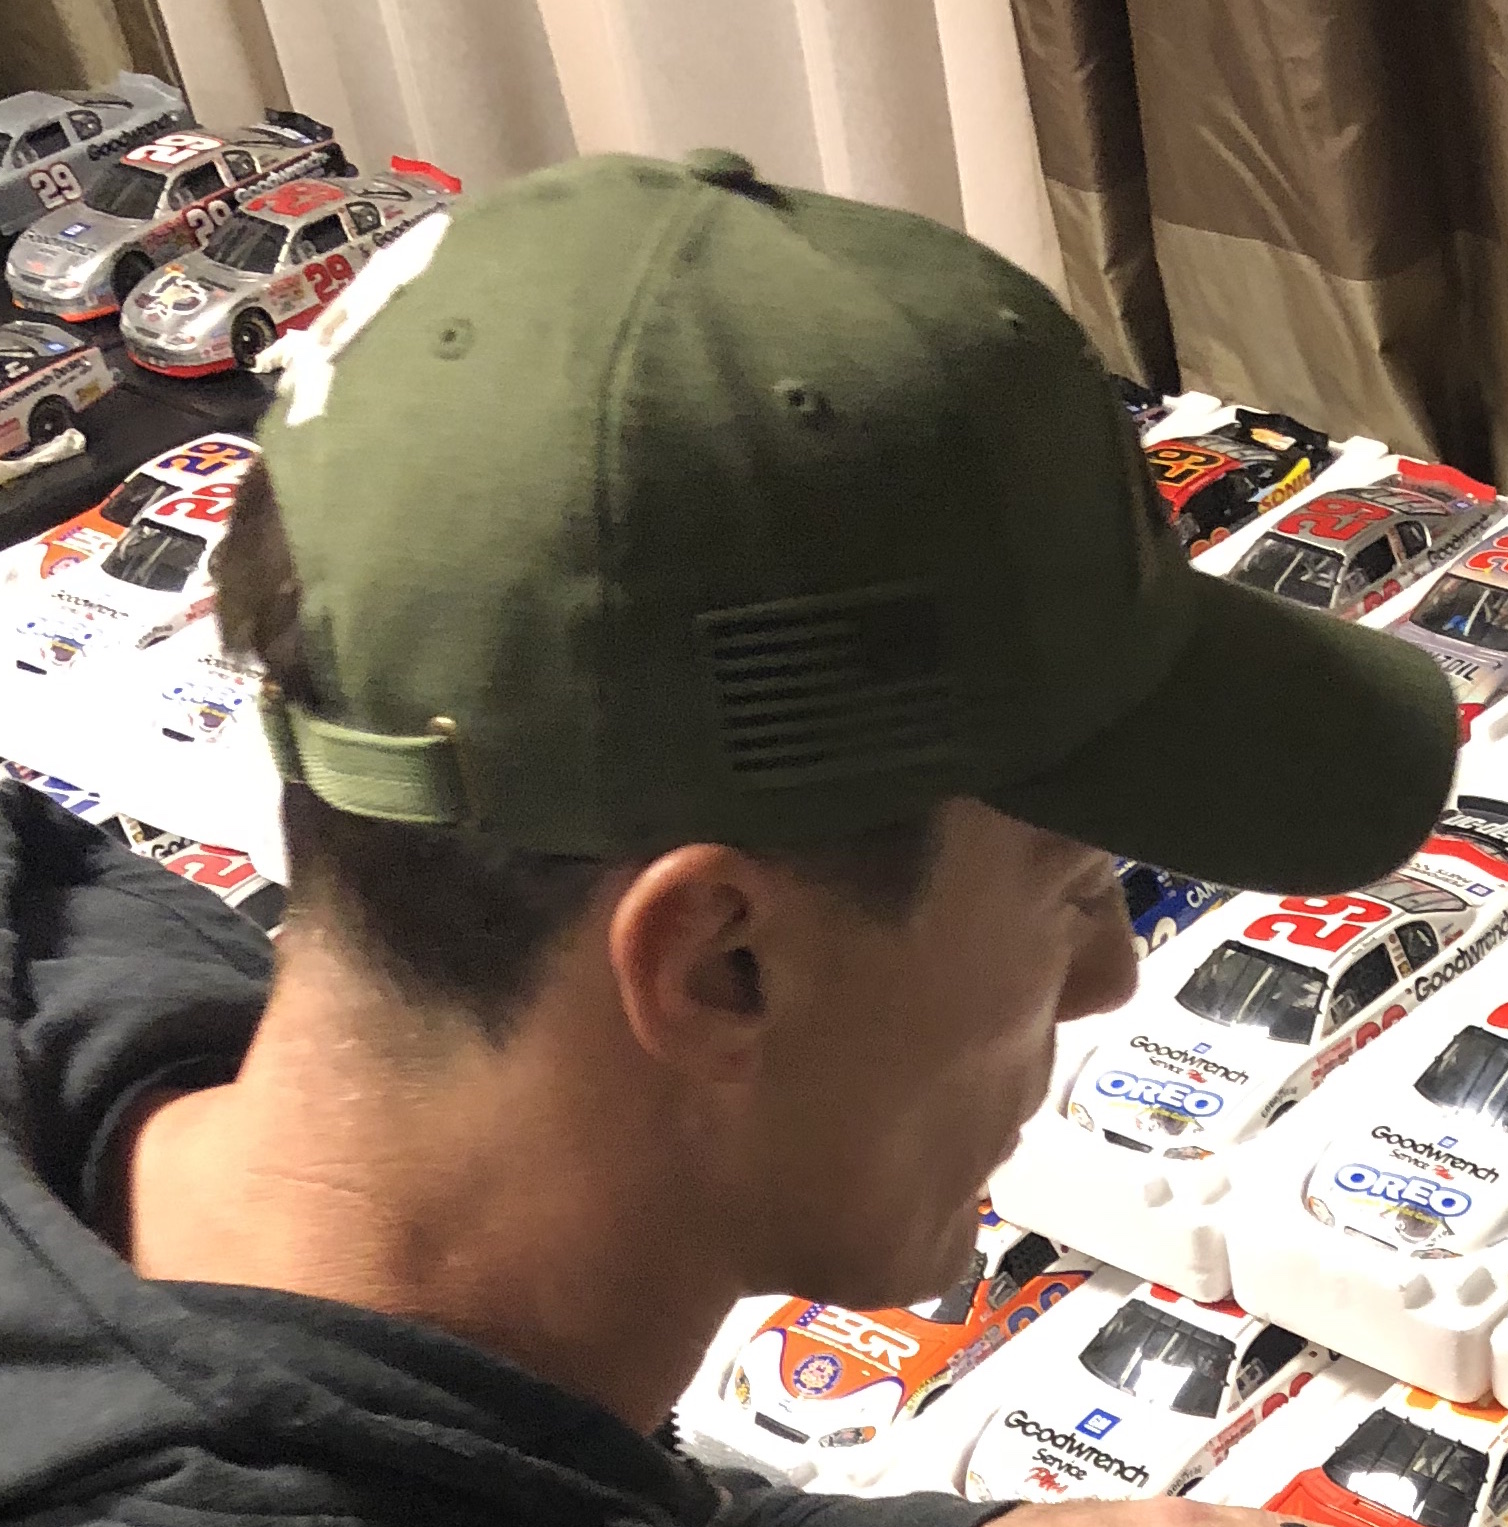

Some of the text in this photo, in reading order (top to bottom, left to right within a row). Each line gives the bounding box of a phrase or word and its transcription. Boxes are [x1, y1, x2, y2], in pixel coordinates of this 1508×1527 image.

[125, 134, 222, 164] 29
[29, 161, 83, 209] 29
[306, 254, 354, 302] 29
[1277, 498, 1394, 541] 29
[1244, 896, 1392, 952] 29
[1130, 1036, 1250, 1085] Goodwrench
[1148, 1056, 1184, 1076] Service
[1097, 1071, 1223, 1117] OREO
[1371, 1126, 1500, 1184] Goodwrench
[1388, 1148, 1429, 1170] Service
[1335, 1164, 1472, 1217] OREO
[1004, 1410, 1150, 1489] Goodwrench
[1032, 1448, 1088, 1481] Service
